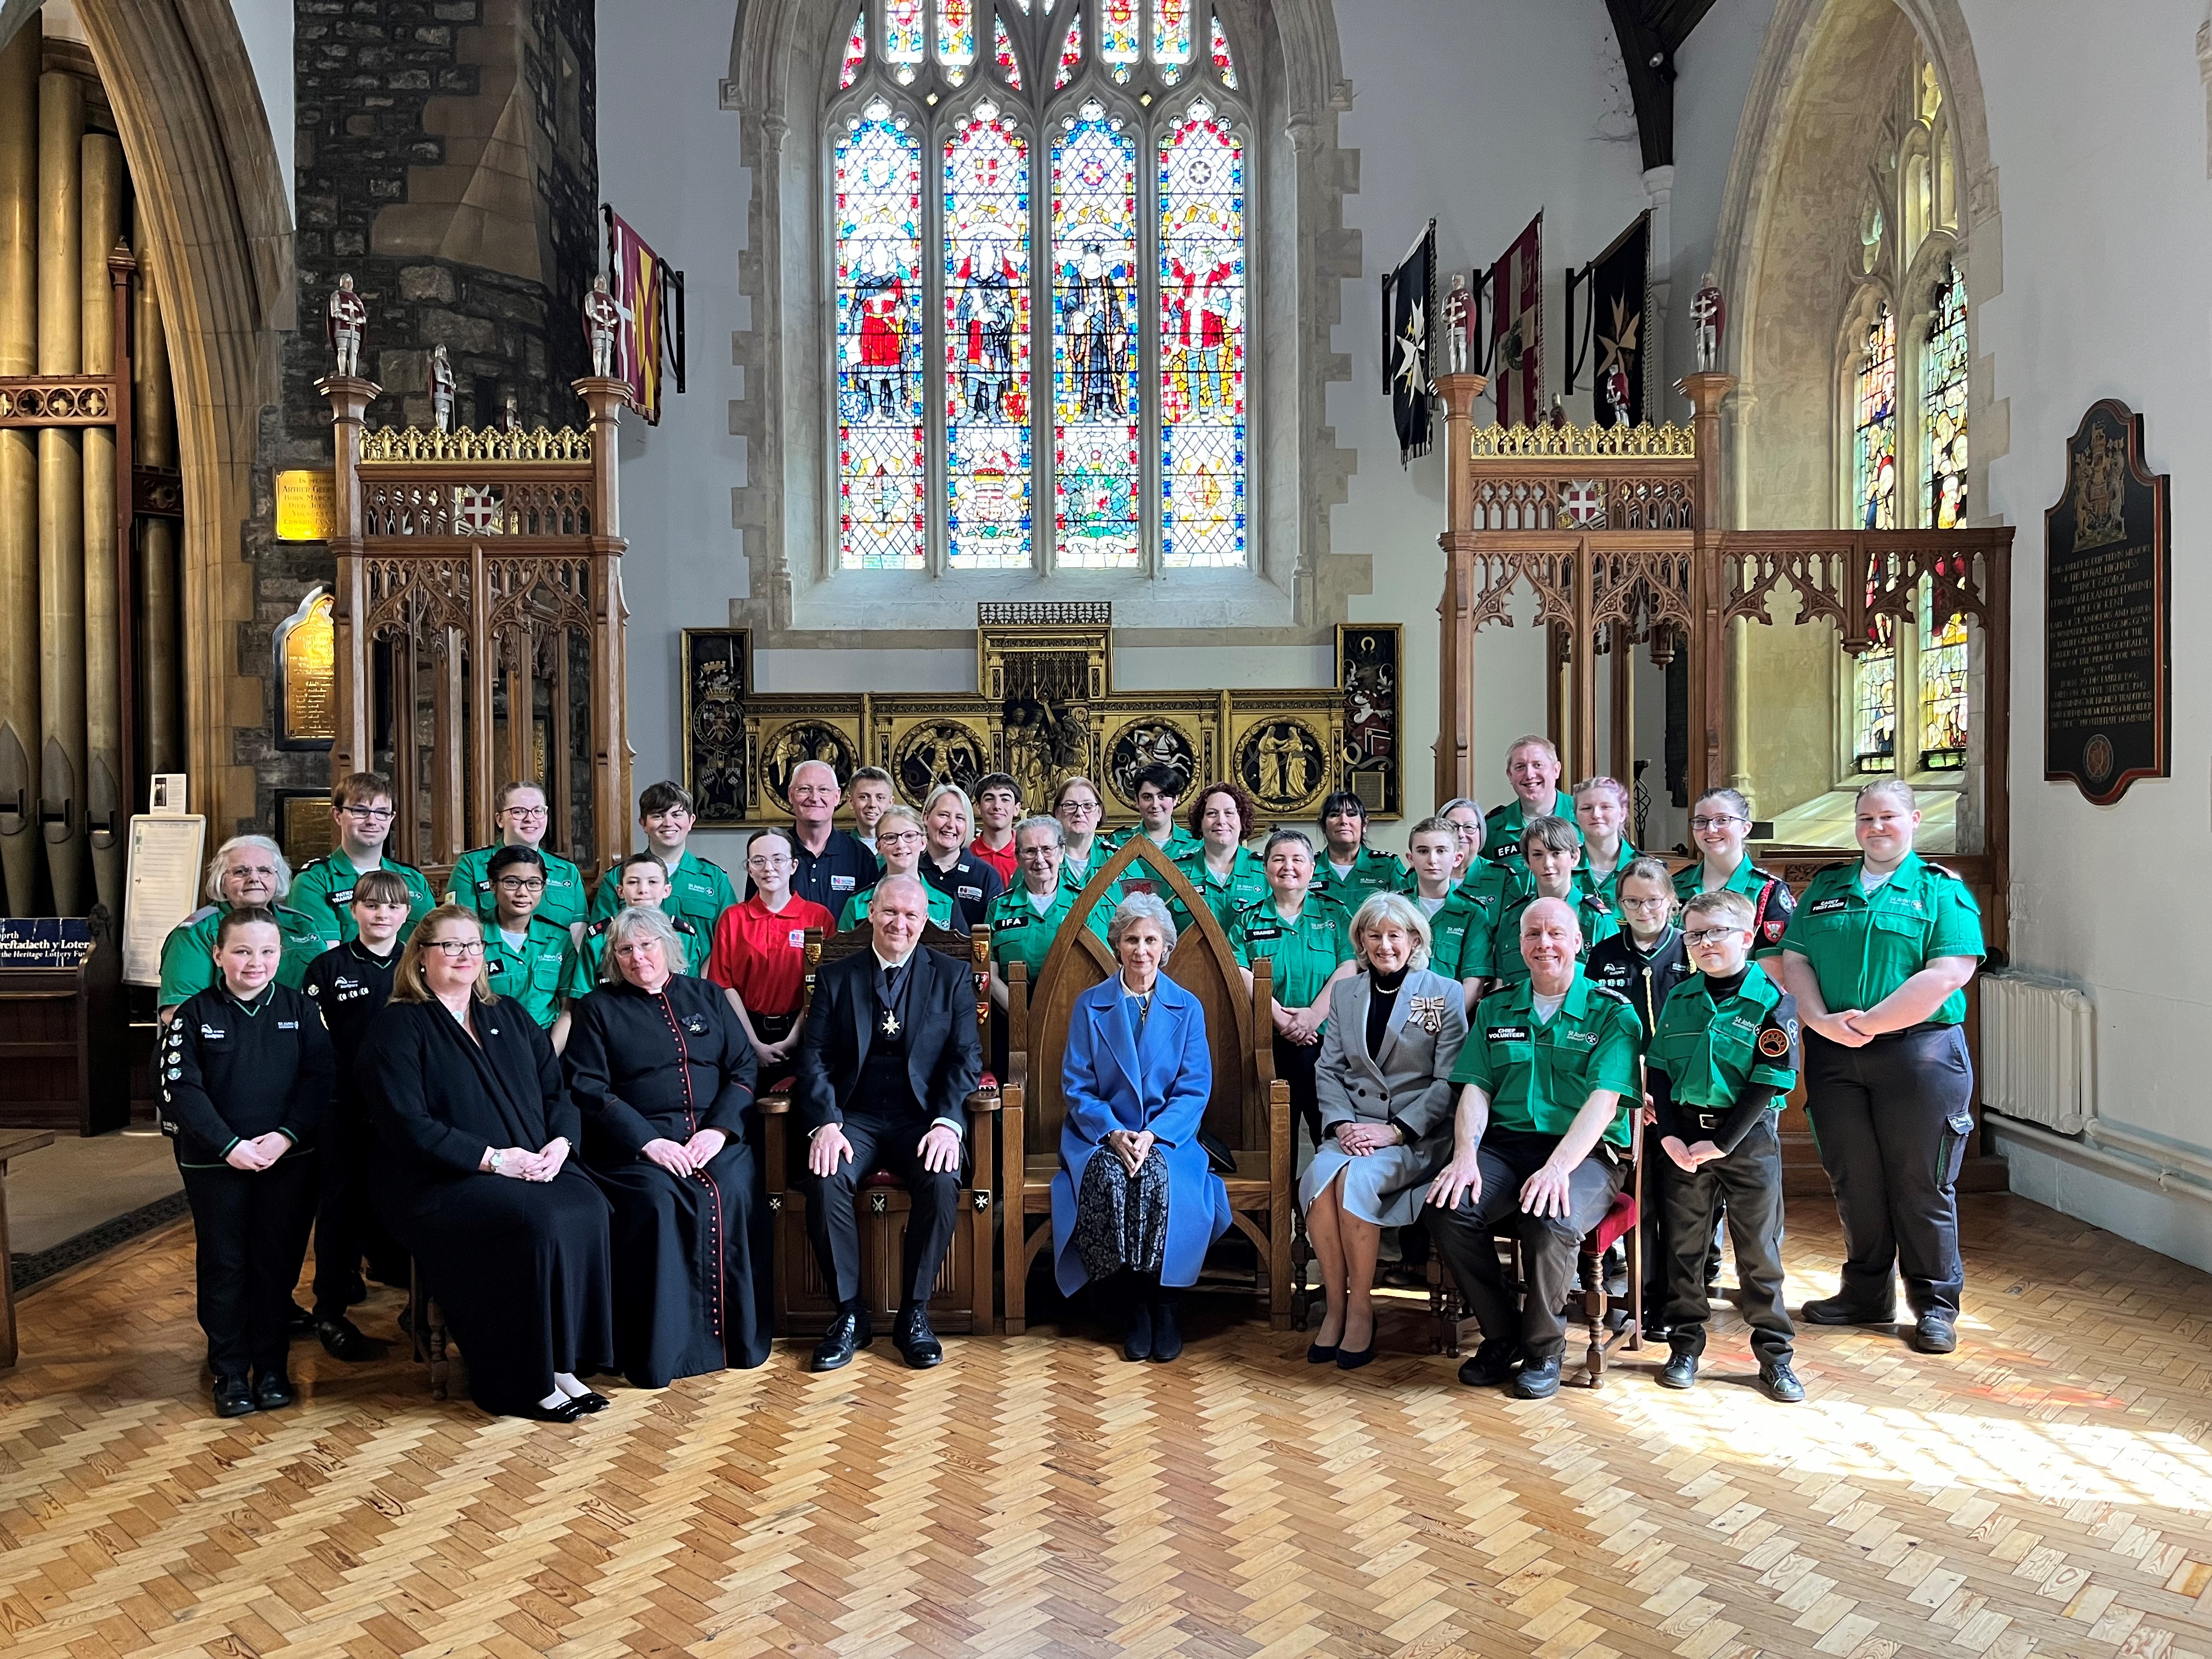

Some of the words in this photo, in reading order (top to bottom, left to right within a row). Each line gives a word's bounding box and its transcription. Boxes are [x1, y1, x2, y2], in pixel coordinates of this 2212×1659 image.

[2083, 567, 2102, 579] ROYAL
[2104, 558, 2138, 573] HIGHNESS
[2072, 580, 2095, 592] PRINCE
[2098, 573, 2125, 586] GEORGE
[2078, 586, 2119, 603] ALEXANDER
[2120, 579, 2152, 594] EDMUND
[2104, 596, 2123, 610] KENT
[2083, 610, 2112, 623] ANDREWS
[2114, 608, 2128, 618] AND
[2078, 635, 2100, 646] GRAND
[2101, 631, 2120, 641] CROSS
[2132, 627, 2142, 636] THE
[2115, 637, 2148, 650] JERUSALEM
[2092, 653, 2113, 663] PRIORY
[2115, 651, 2128, 660] FOR
[2089, 674, 2122, 685] DECEMBER
[2133, 680, 2147, 690] 1942
[1498, 845, 1517, 856] EFA
[1002, 918, 1021, 927] IFA
[52, 942, 59, 952] y
[13, 951, 43, 960] Heritage
[45, 950, 72, 960] Lottery
[1741, 1019, 1754, 1029] John
